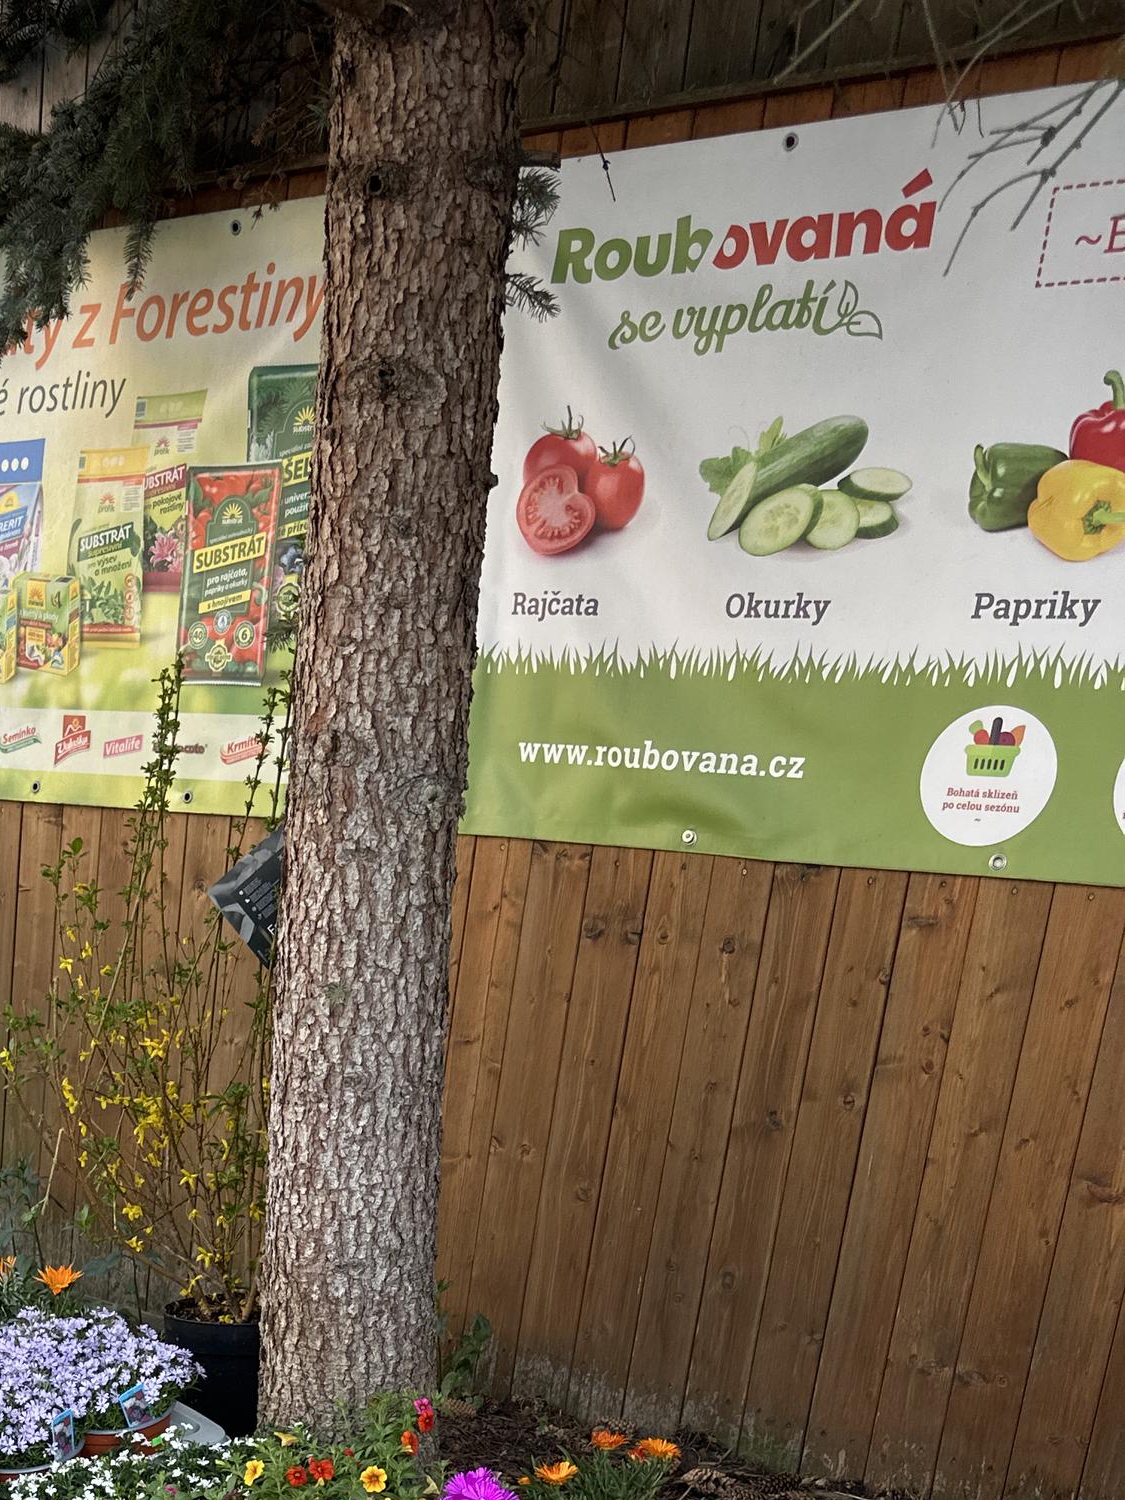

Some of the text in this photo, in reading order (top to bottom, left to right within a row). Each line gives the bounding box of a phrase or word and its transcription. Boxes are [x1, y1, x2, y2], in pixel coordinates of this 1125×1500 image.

[550, 168, 938, 284] Roubovaná
[71, 302, 102, 349] z
[608, 279, 843, 357] se vyplatí
[17, 370, 127, 418] rostliny
[80, 524, 132, 552] SUBSTRÁT
[195, 535, 264, 570] SUBSTRÁT
[512, 591, 599, 622] Rajčata
[725, 592, 831, 626] Okurky
[971, 591, 1101, 627] Papriky
[105, 739, 141, 755] Vitalife
[518, 739, 806, 779] www.roubovana.cz
[941, 801, 954, 811] po
[956, 800, 982, 812] celou
[946, 787, 979, 799] Bohatá
